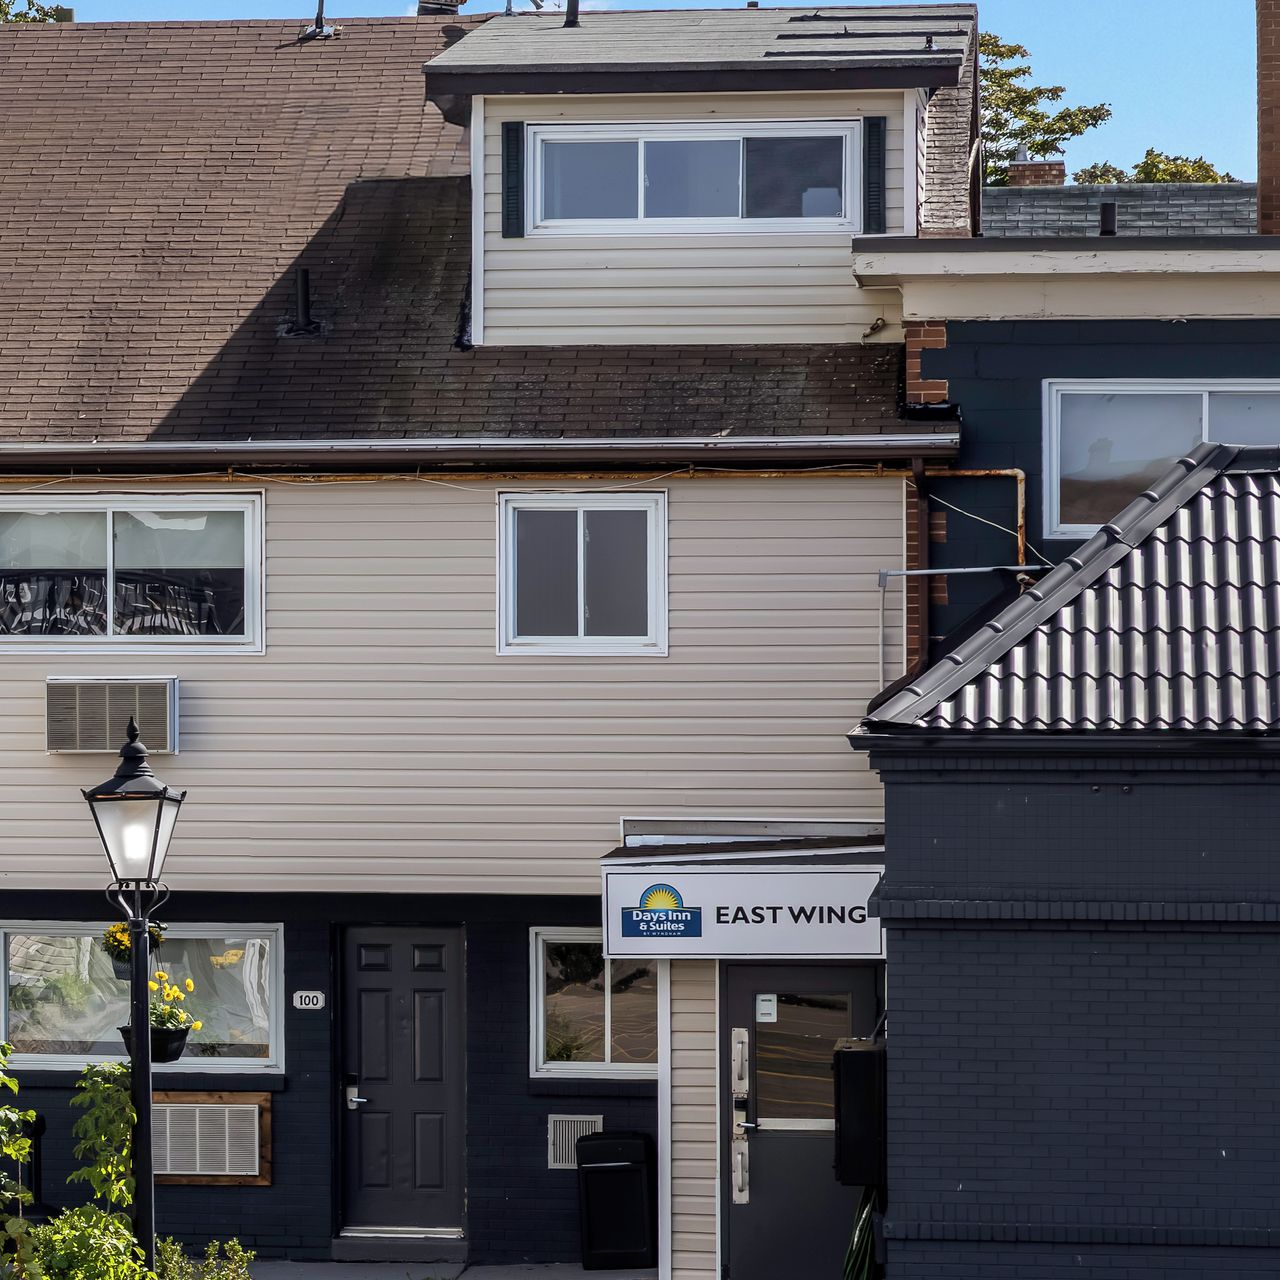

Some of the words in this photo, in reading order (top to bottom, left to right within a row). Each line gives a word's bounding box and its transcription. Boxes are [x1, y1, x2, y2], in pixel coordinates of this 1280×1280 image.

[632, 910, 666, 922] Days
[668, 910, 691, 921] Inn
[716, 906, 783, 924] EAST
[788, 905, 867, 924] WING
[639, 922, 648, 931] &
[649, 921, 685, 931] Suites
[299, 994, 319, 1006] 100
